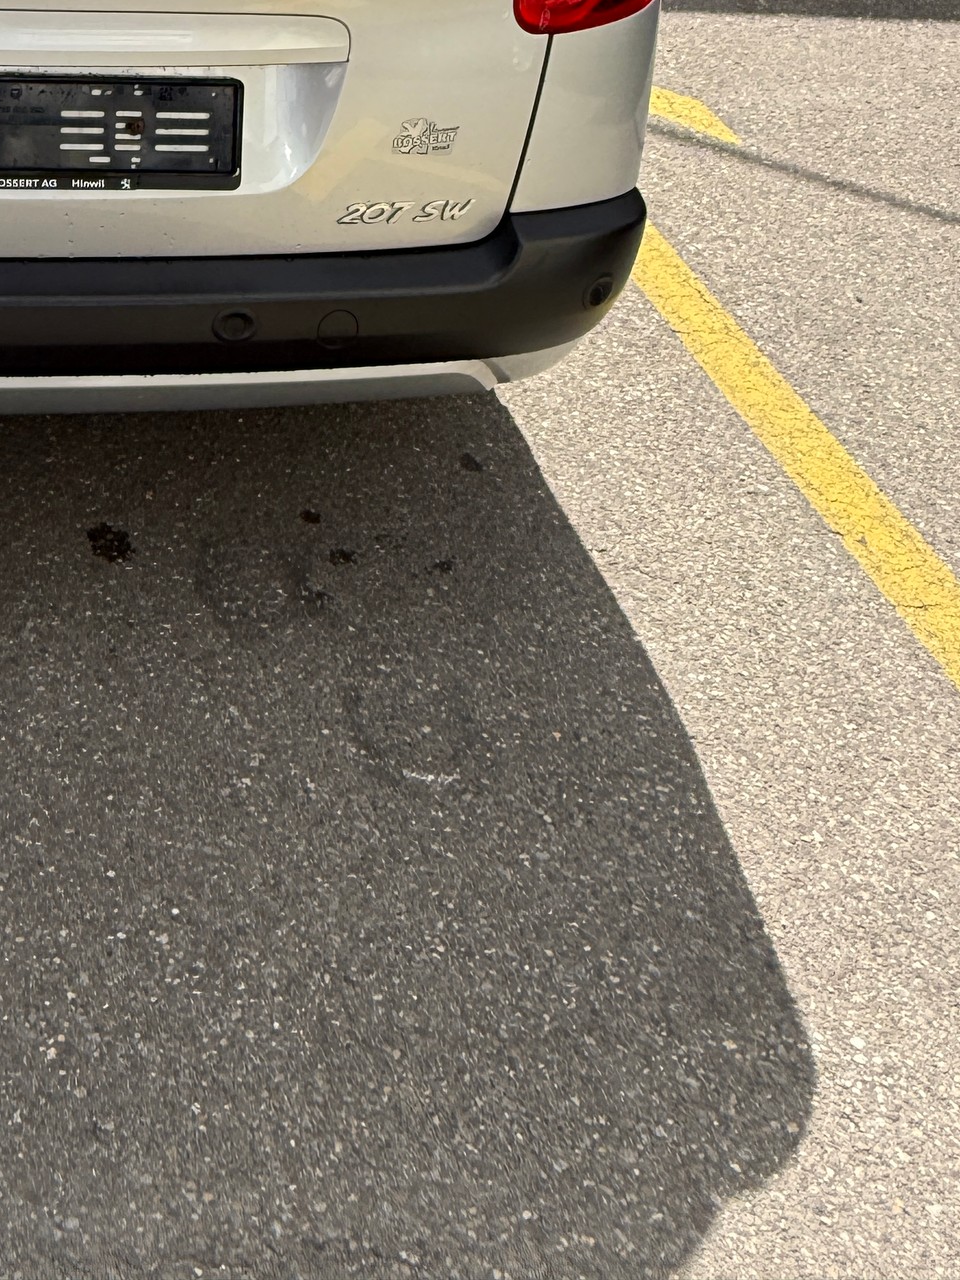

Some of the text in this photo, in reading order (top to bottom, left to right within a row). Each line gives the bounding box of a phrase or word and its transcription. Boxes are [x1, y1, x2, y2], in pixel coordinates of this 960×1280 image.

[393, 131, 457, 148] BOSSERT
[41, 179, 57, 188] AG
[72, 178, 105, 188] Hinwil
[337, 198, 476, 224] 207 SW
